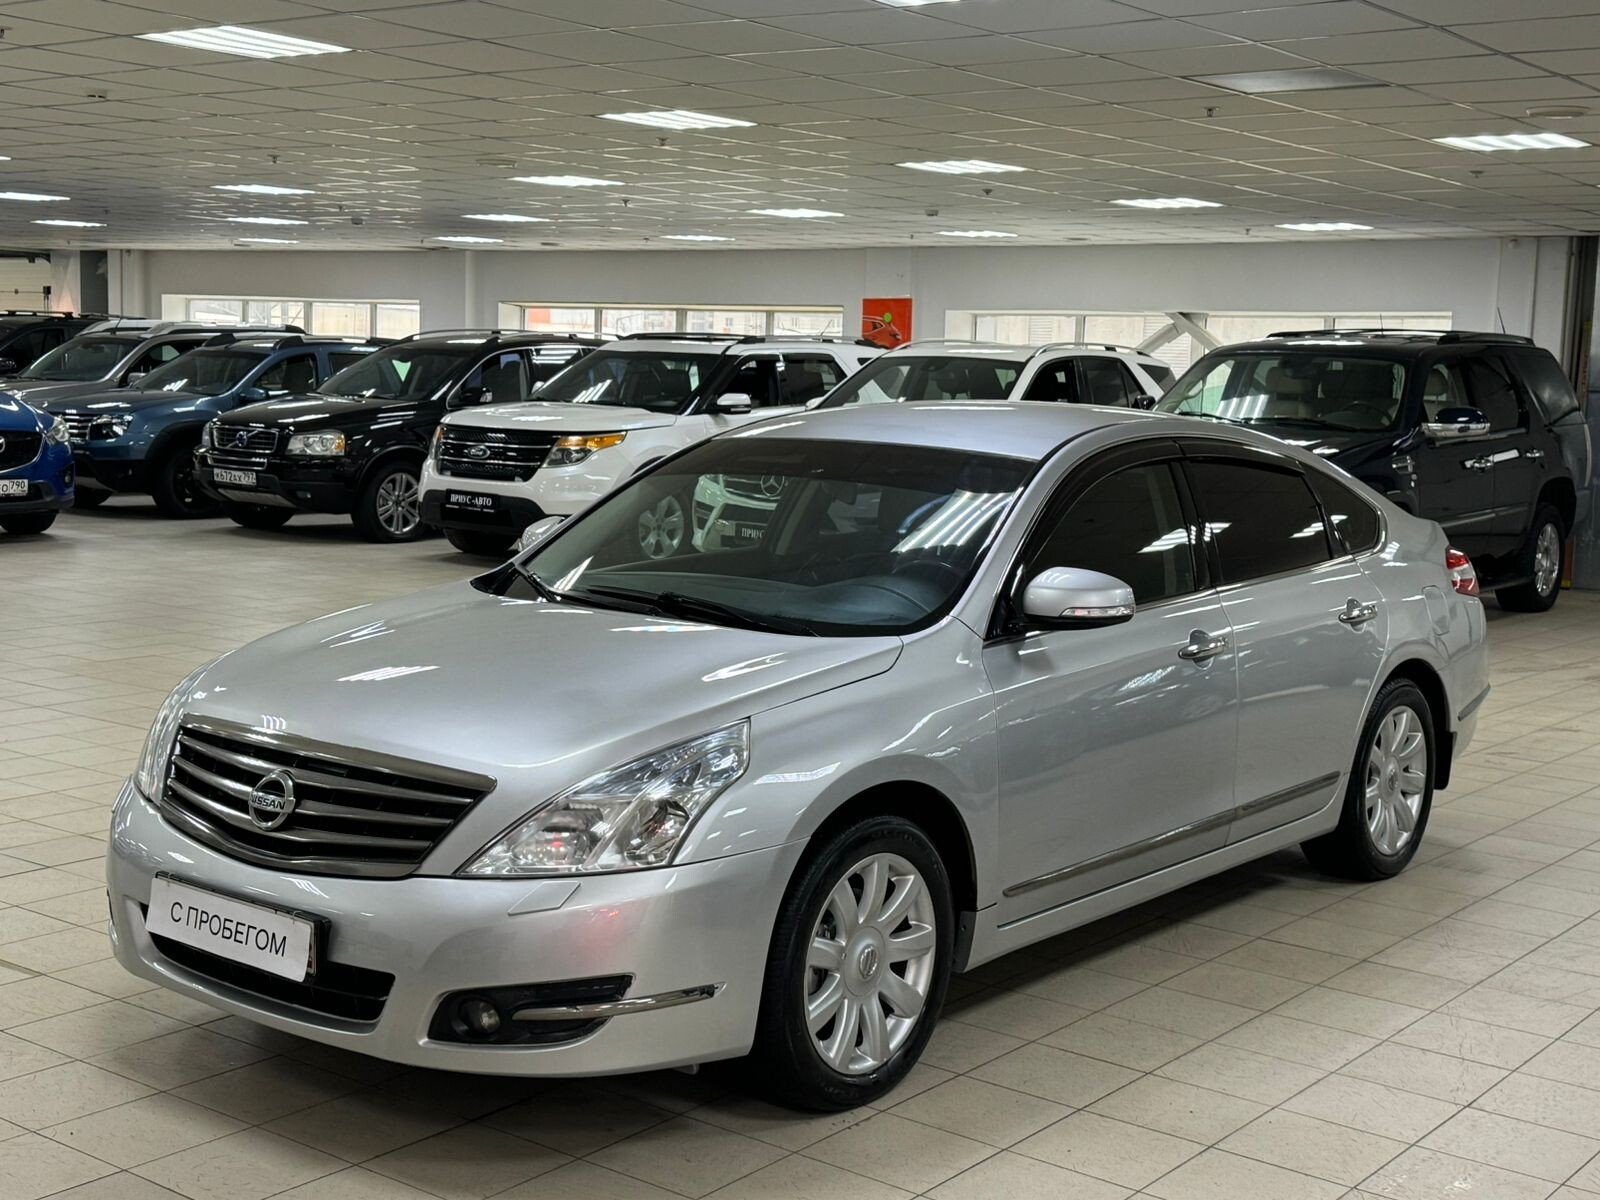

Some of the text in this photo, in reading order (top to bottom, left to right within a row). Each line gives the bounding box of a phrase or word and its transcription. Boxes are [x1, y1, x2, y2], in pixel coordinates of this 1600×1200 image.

[10, 480, 26, 489] 790
[251, 793, 286, 810] NISSAN
[170, 901, 287, 957] С ПРОБЕГОМ
